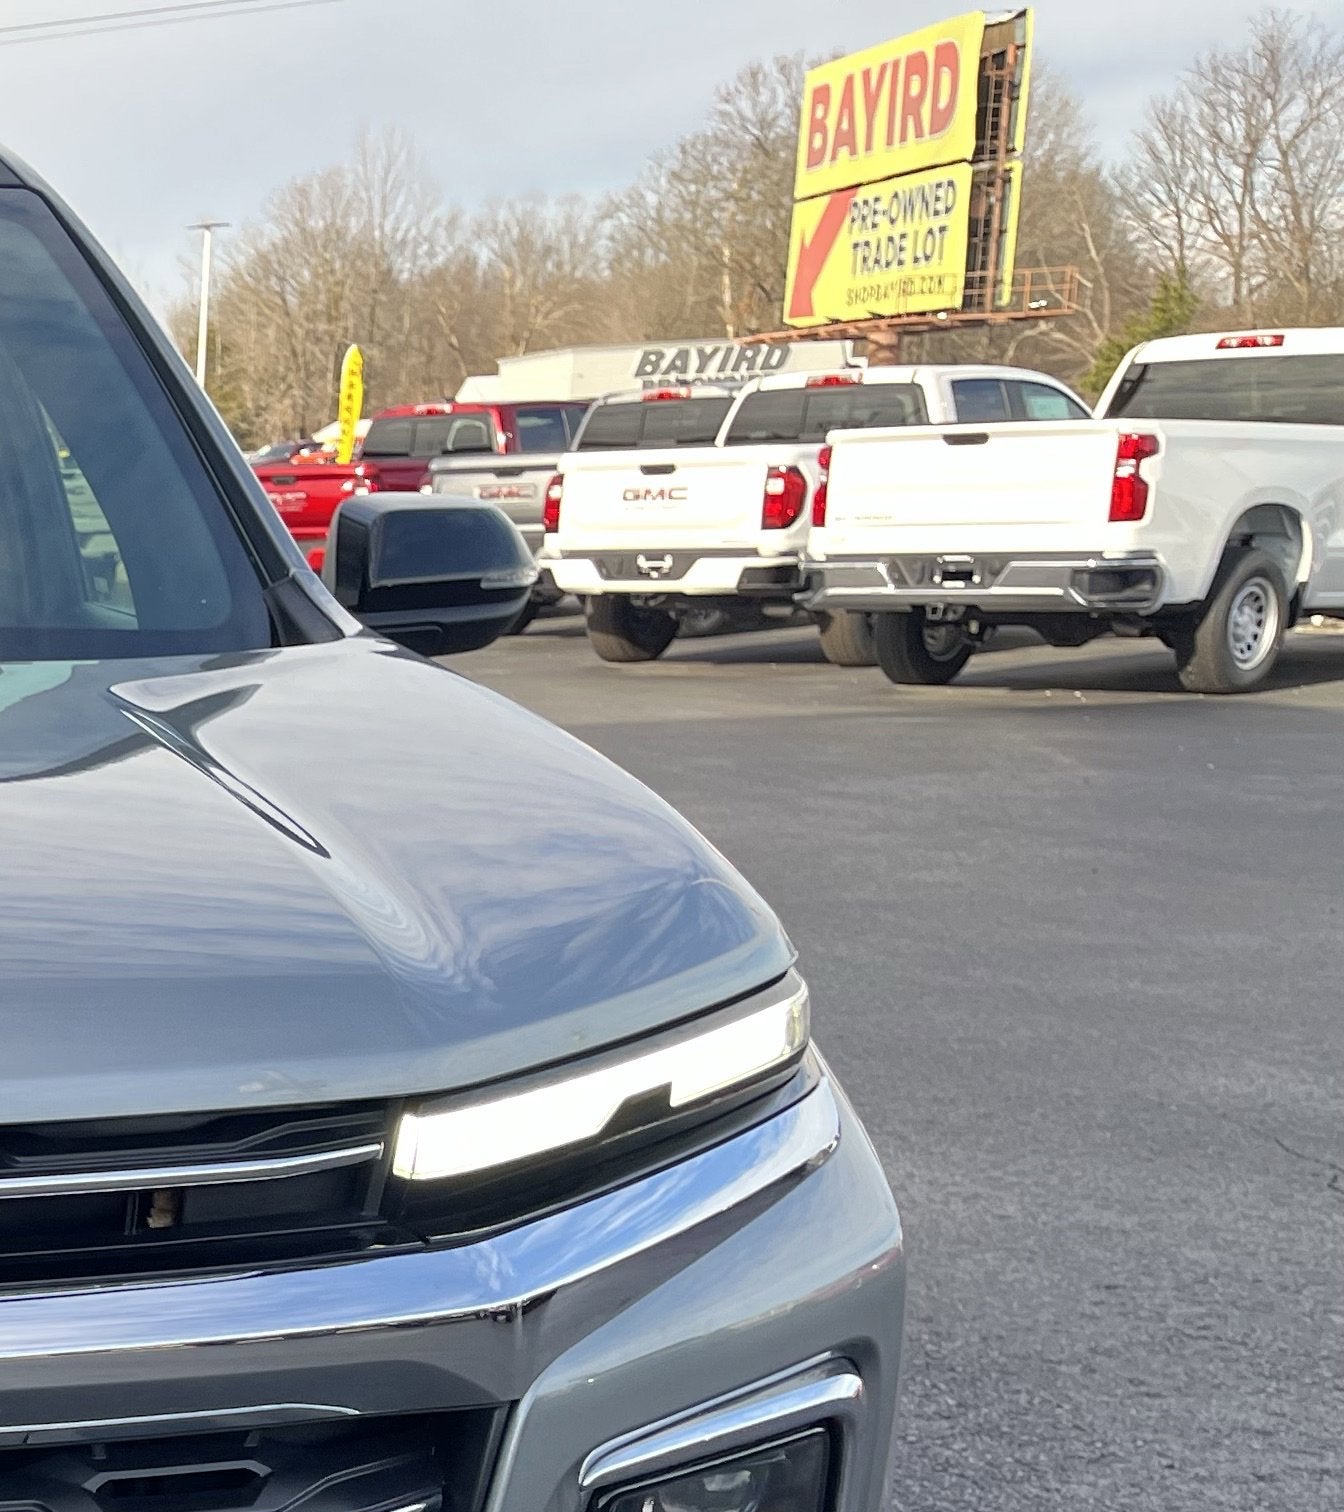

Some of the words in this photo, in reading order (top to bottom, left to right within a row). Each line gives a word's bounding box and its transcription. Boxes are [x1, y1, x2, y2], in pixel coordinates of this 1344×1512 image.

[806, 41, 960, 169] BAYIRD
[848, 179, 957, 234] PRE-OWNED
[853, 231, 908, 277] TRADE
[913, 225, 949, 266] LOT
[635, 343, 792, 377] BAYIRD
[622, 487, 689, 501] GMC
